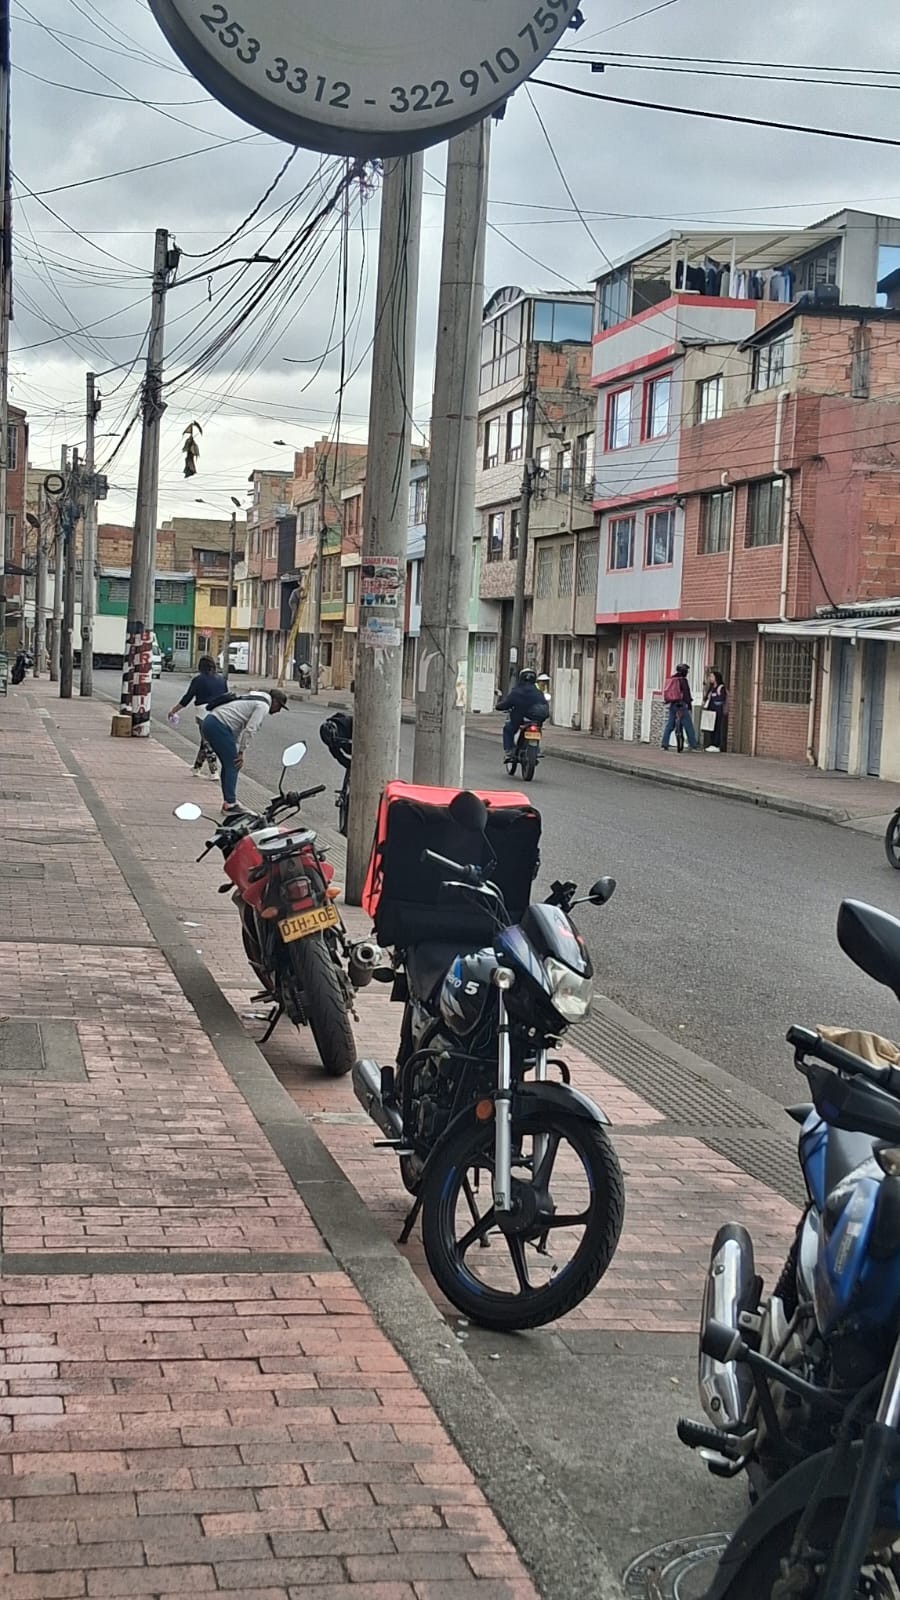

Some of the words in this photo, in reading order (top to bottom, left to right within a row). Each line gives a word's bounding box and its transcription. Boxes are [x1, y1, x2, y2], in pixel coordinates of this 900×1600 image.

[200, 4, 260, 64] 253
[266, 57, 351, 109] 3312
[390, 80, 454, 112] 322
[460, 48, 520, 96] 910
[464, 981, 480, 995] 5
